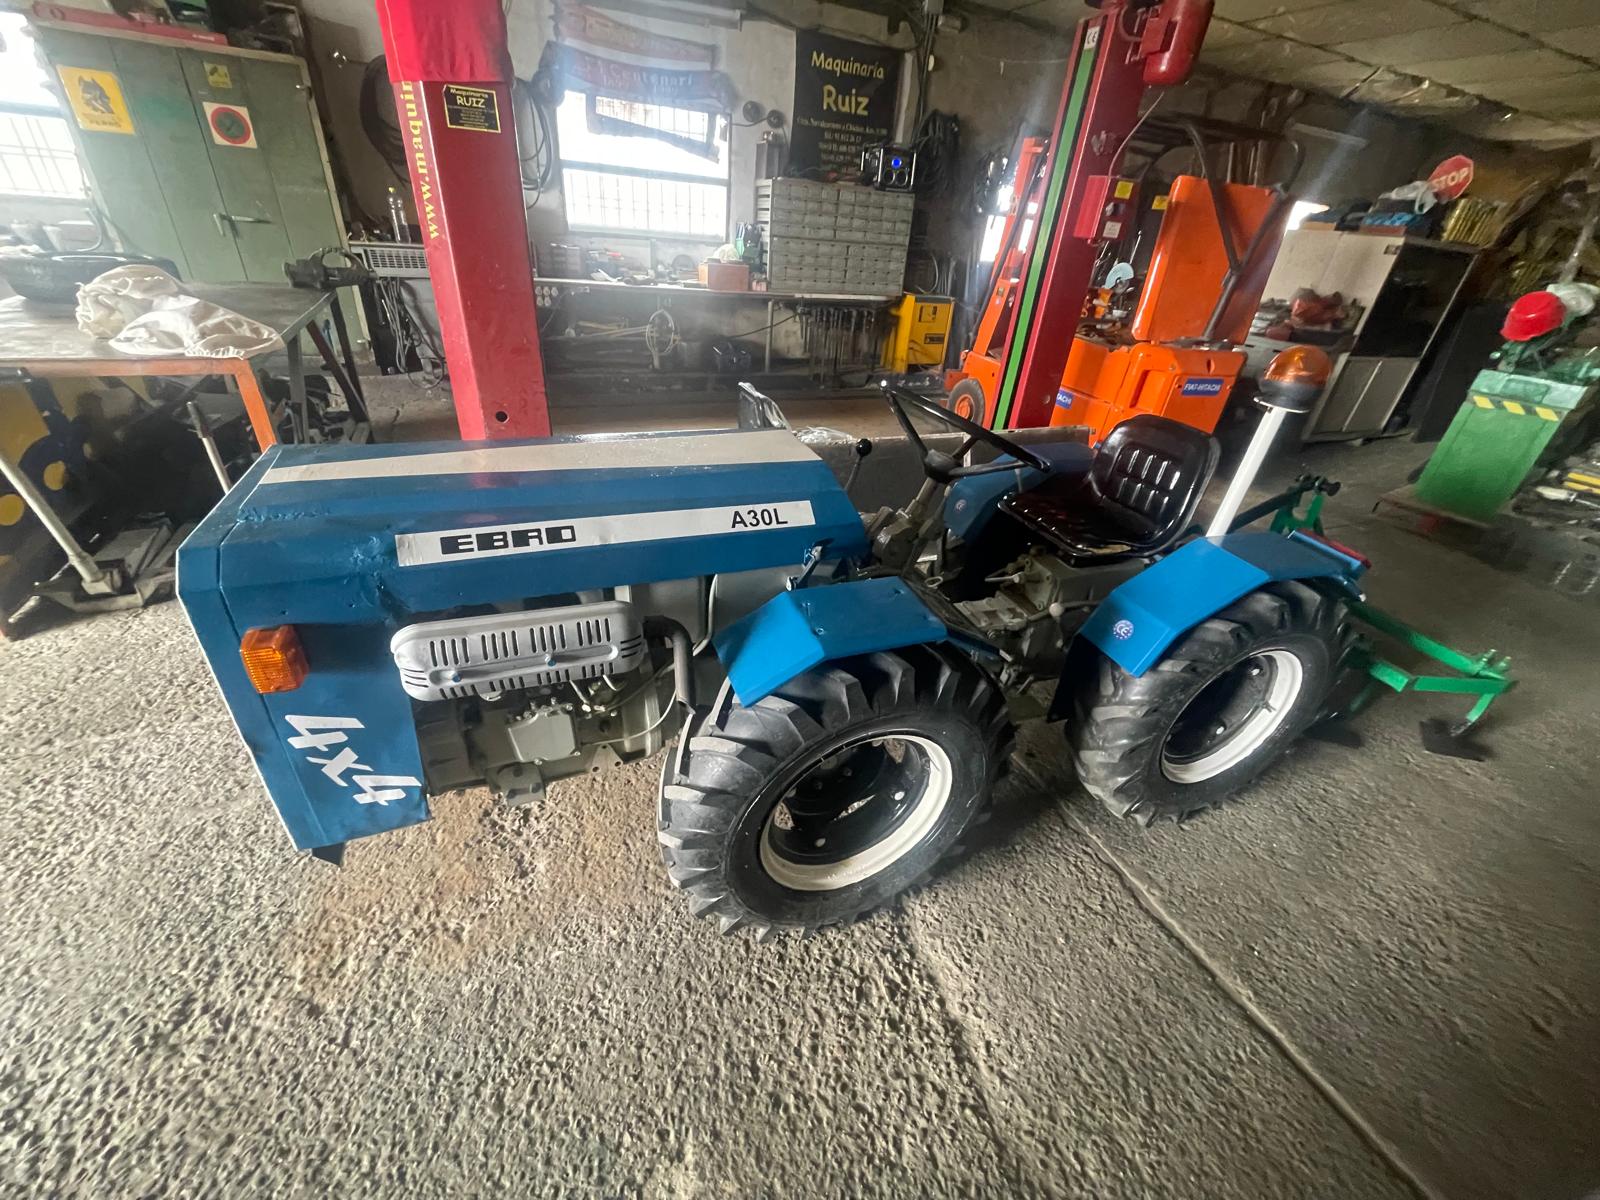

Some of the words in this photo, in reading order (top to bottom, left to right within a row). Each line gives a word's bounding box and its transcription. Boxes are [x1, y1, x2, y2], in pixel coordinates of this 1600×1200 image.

[456, 95, 486, 108] RUIZ
[822, 84, 870, 116] Ruiz
[1429, 167, 1469, 193] STOP
[731, 508, 788, 528] A30L
[440, 525, 577, 555] EBRO
